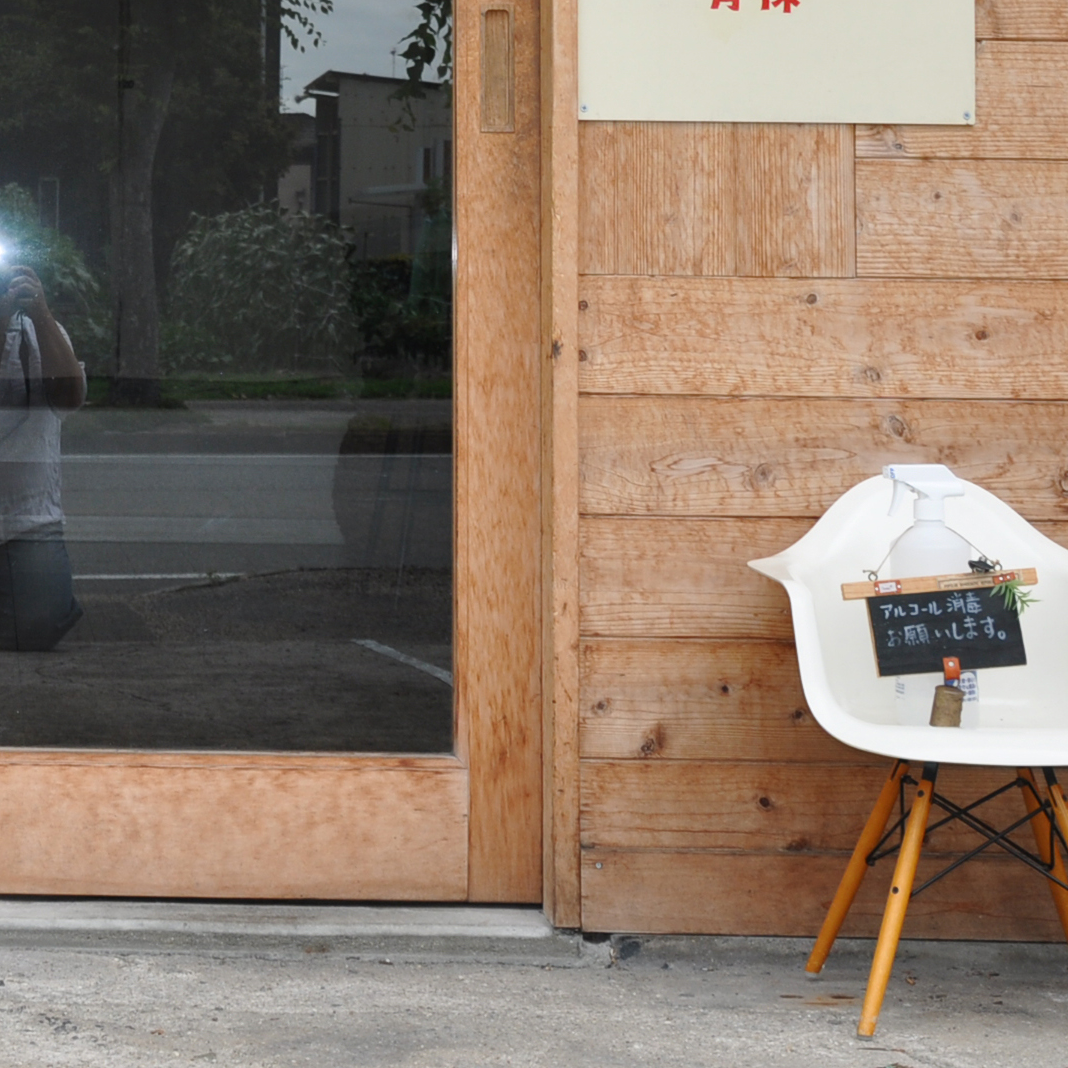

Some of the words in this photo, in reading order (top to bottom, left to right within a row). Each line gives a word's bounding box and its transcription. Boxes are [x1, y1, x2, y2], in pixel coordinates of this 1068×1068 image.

[879, 592, 983, 620] アルコール消毒
[886, 616, 1007, 647] お願いします。
